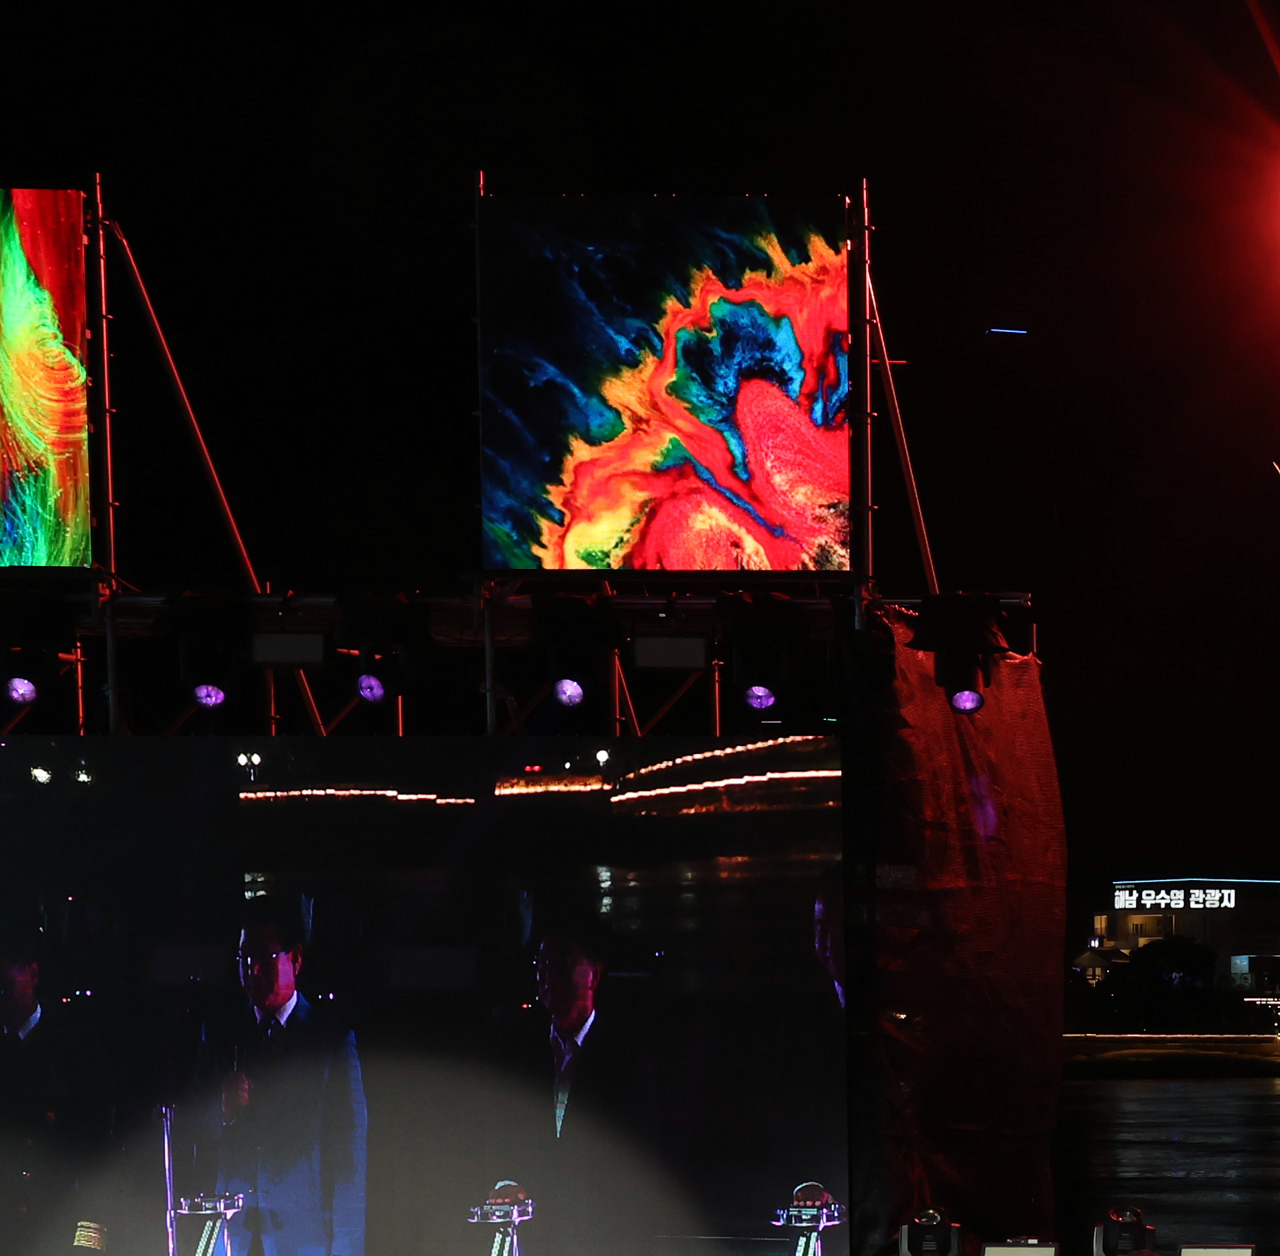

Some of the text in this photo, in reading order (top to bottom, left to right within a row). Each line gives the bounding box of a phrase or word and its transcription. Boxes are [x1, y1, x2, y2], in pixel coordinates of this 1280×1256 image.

[1114, 889, 1235, 909] 해남 우수영 관광지
